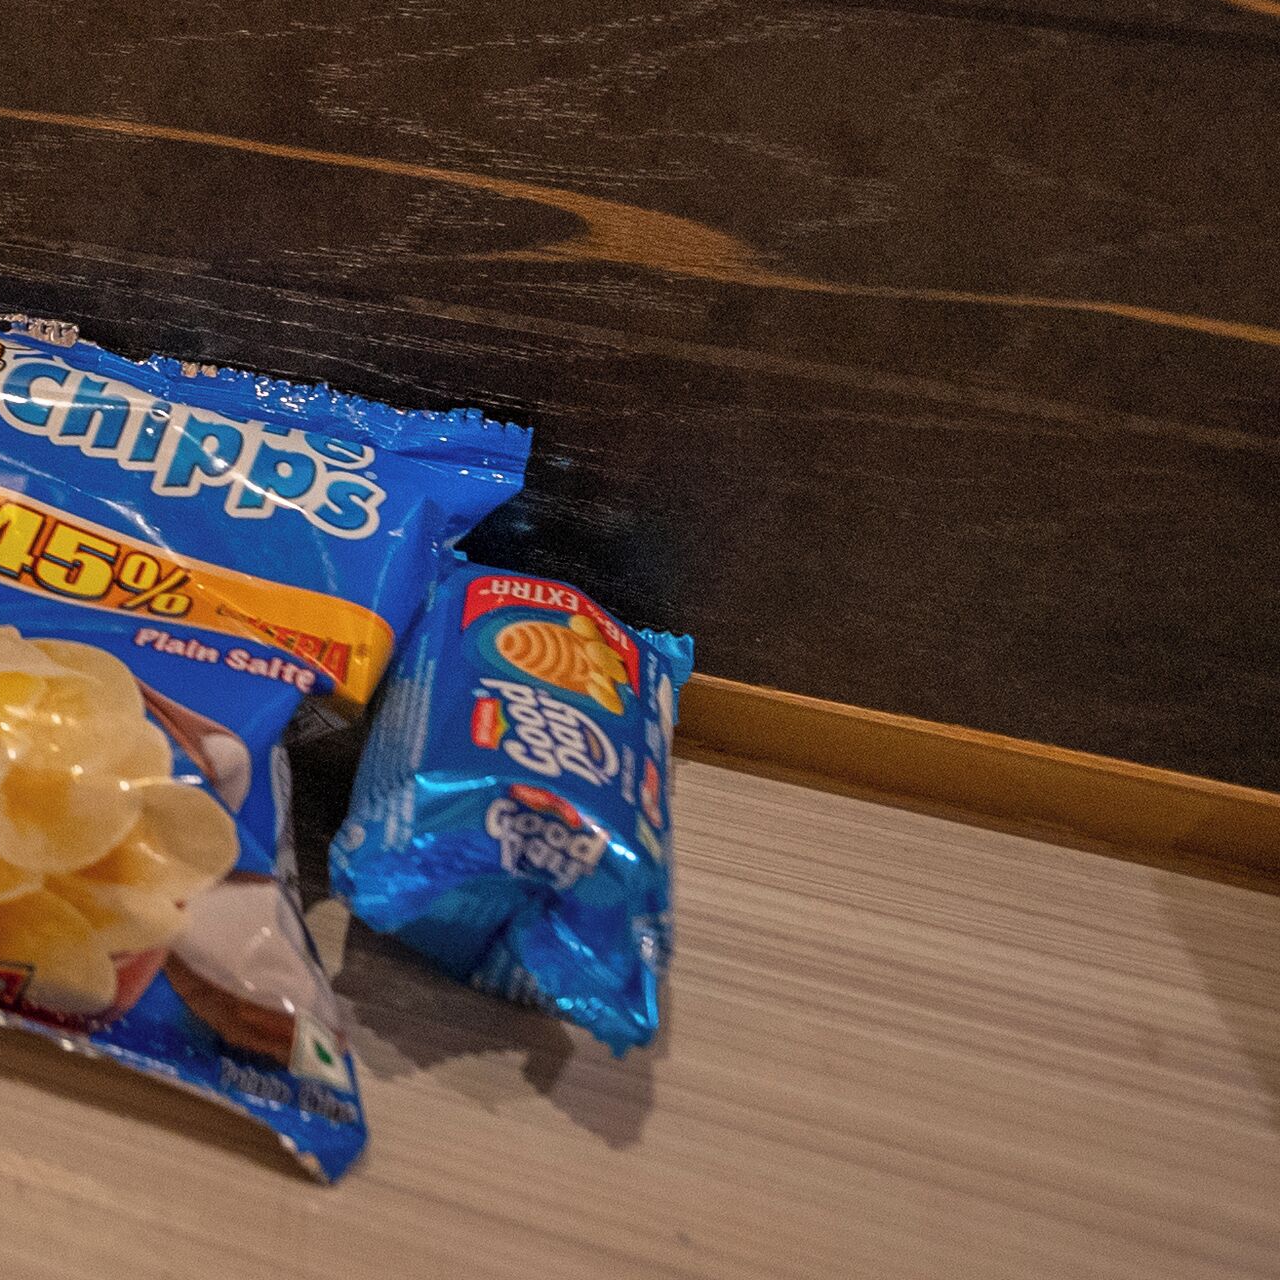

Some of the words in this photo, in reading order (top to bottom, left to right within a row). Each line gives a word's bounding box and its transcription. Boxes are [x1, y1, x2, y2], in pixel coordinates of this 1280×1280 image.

[0, 358, 380, 535] Chipps
[135, 627, 220, 664] Plain
[479, 677, 562, 779] Good
